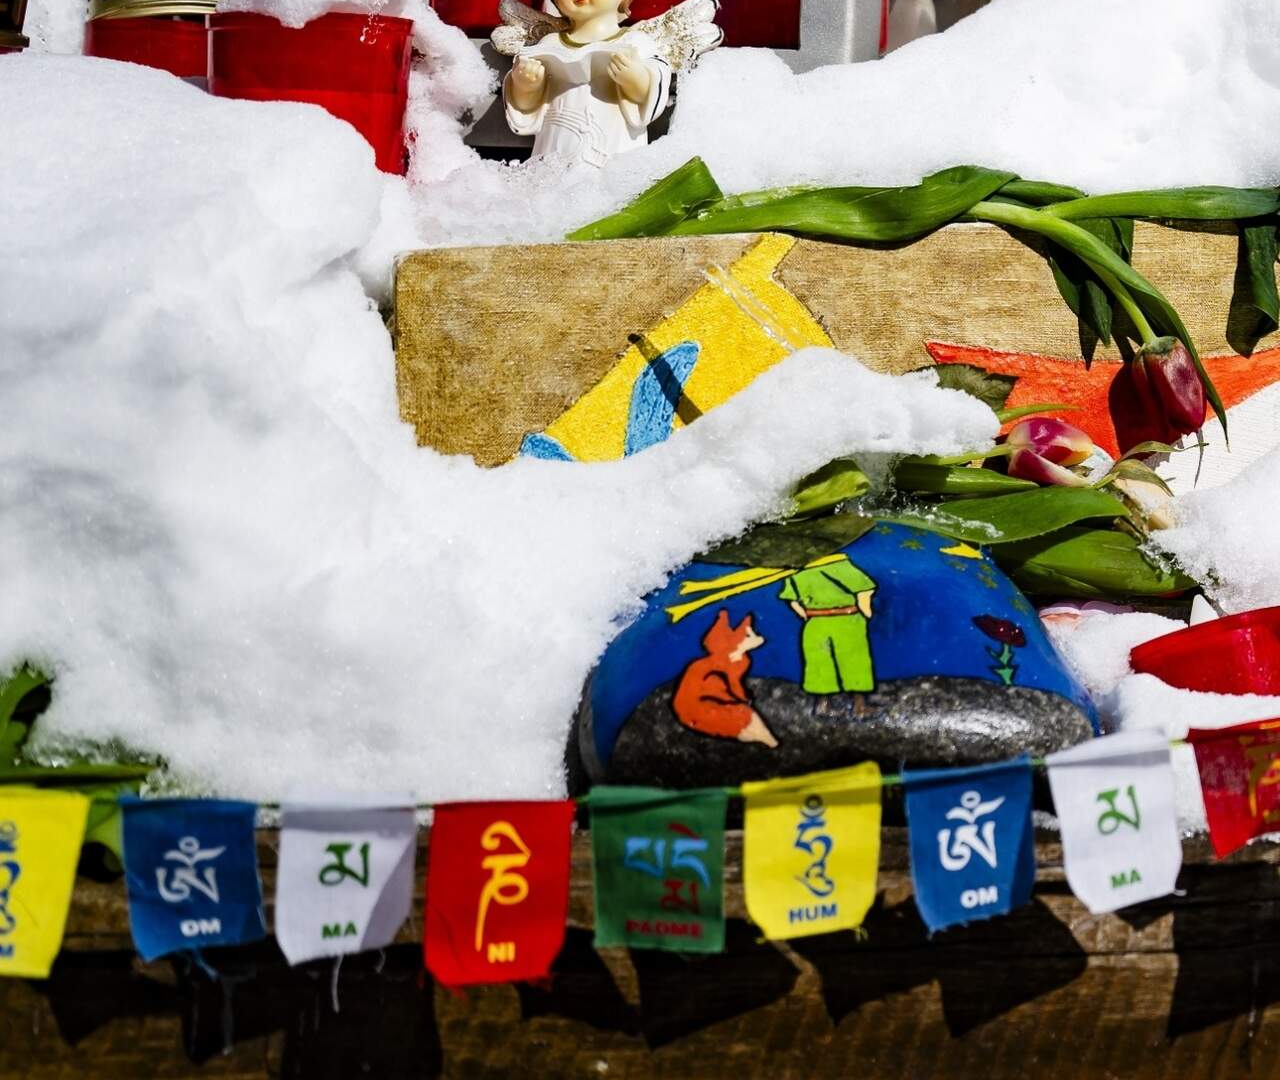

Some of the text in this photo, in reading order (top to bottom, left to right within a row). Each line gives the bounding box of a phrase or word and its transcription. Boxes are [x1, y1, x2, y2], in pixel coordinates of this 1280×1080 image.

[1111, 869, 1142, 890] MA
[960, 885, 999, 909] OM
[788, 903, 837, 923] HUM
[179, 917, 222, 937] OM
[321, 920, 358, 939] MA
[625, 919, 705, 939] PADME
[487, 941, 517, 963] NI
